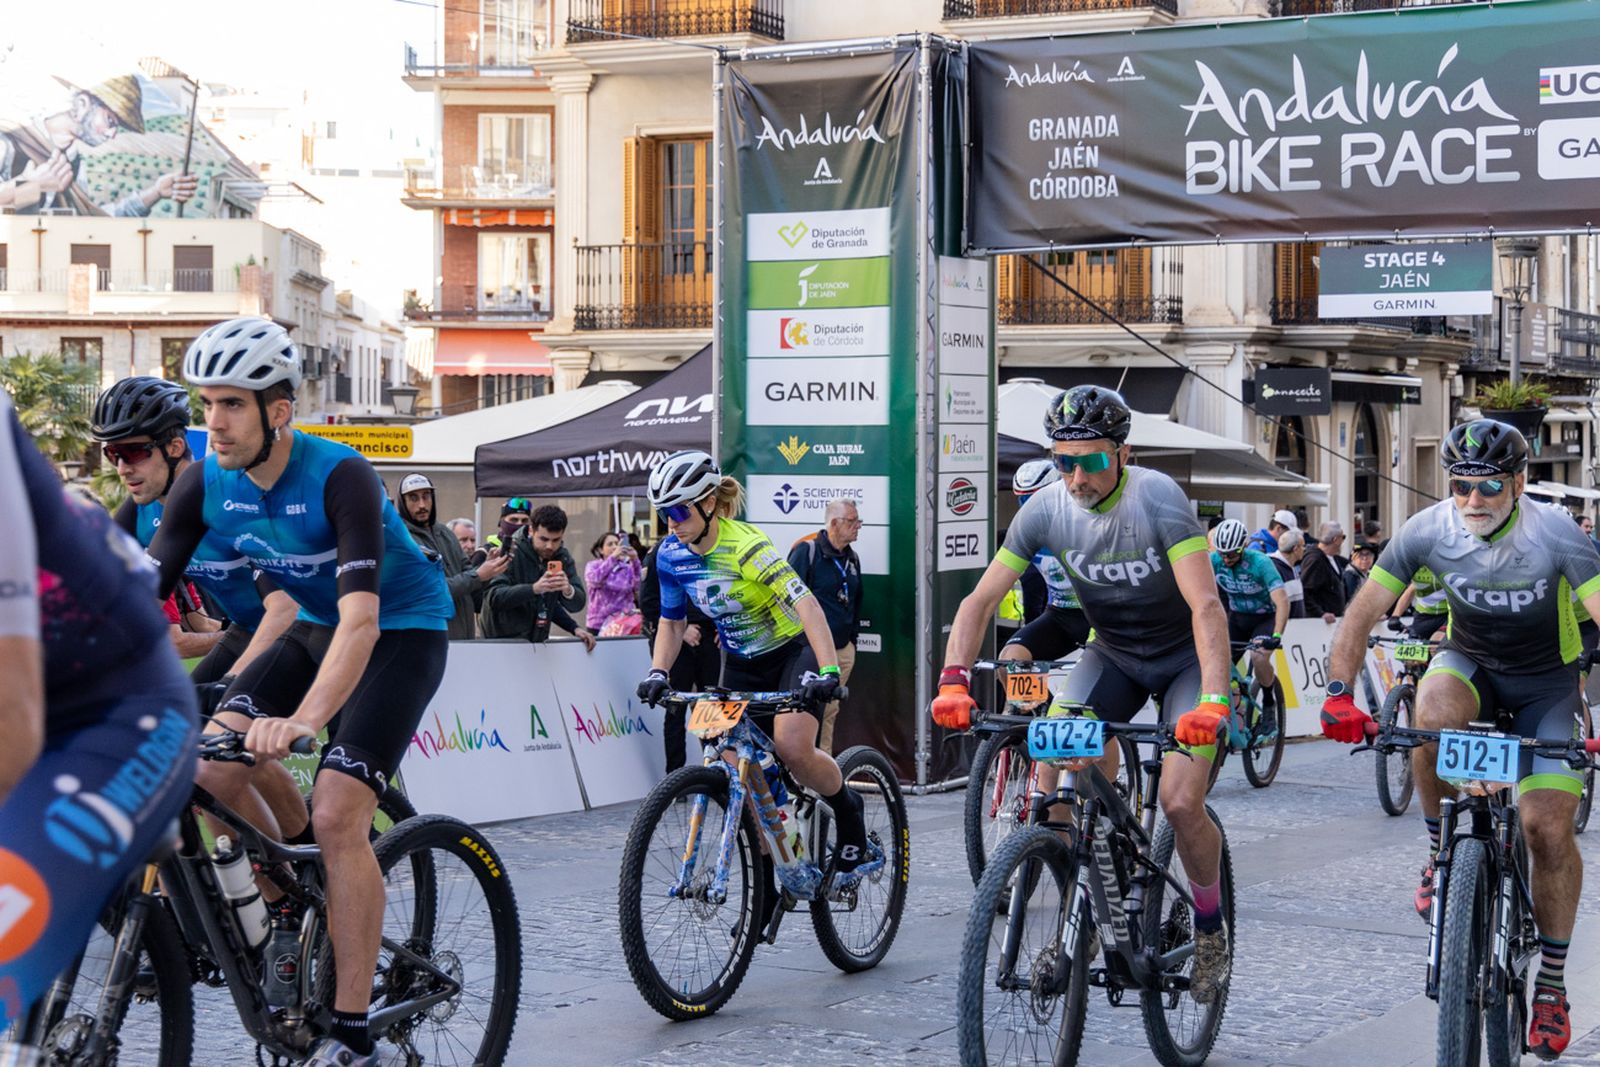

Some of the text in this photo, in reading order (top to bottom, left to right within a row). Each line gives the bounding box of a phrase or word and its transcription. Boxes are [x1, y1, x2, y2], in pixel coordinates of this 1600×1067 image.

[1004, 60, 1095, 88] Andalucía
[1180, 42, 1519, 137] Andalucía
[755, 109, 885, 151] Andalucía
[1029, 114, 1119, 141] GRANADA
[1523, 127, 1537, 137] BY
[1047, 143, 1099, 170] JAÉN
[1186, 125, 1521, 195] BIKE RACE
[1029, 174, 1119, 201] CÓRDOBA
[811, 227, 865, 240] Diputación
[811, 238, 868, 249] de Granada
[1364, 250, 1446, 269] STAGE 4
[1379, 270, 1431, 289] JAÉN
[1373, 298, 1436, 311] GARMIN
[814, 323, 864, 335] Diputación
[813, 335, 864, 346] de Córdoba
[942, 332, 985, 348] GARMIN
[765, 381, 876, 402] GARMIN
[368, 430, 409, 439] municipal
[951, 434, 976, 454] Jaén
[1054, 431, 1096, 440] GripGrab
[812, 444, 865, 454] CAJA RURAL
[552, 449, 678, 478] northwa
[828, 455, 850, 466] JAÉN
[1452, 467, 1494, 476] GripGrab
[945, 534, 979, 557] SER
[1397, 646, 1426, 658] 440-1
[1010, 676, 1044, 696] 702-1
[570, 698, 653, 745] Andalucía
[695, 702, 743, 724] 702-2
[409, 708, 511, 759] Andalucía
[1034, 721, 1098, 750] 512-2
[1445, 738, 1511, 774] 512-1
[459, 836, 501, 878] MAXXIS
[1092, 825, 1130, 941] PECIALIZED
